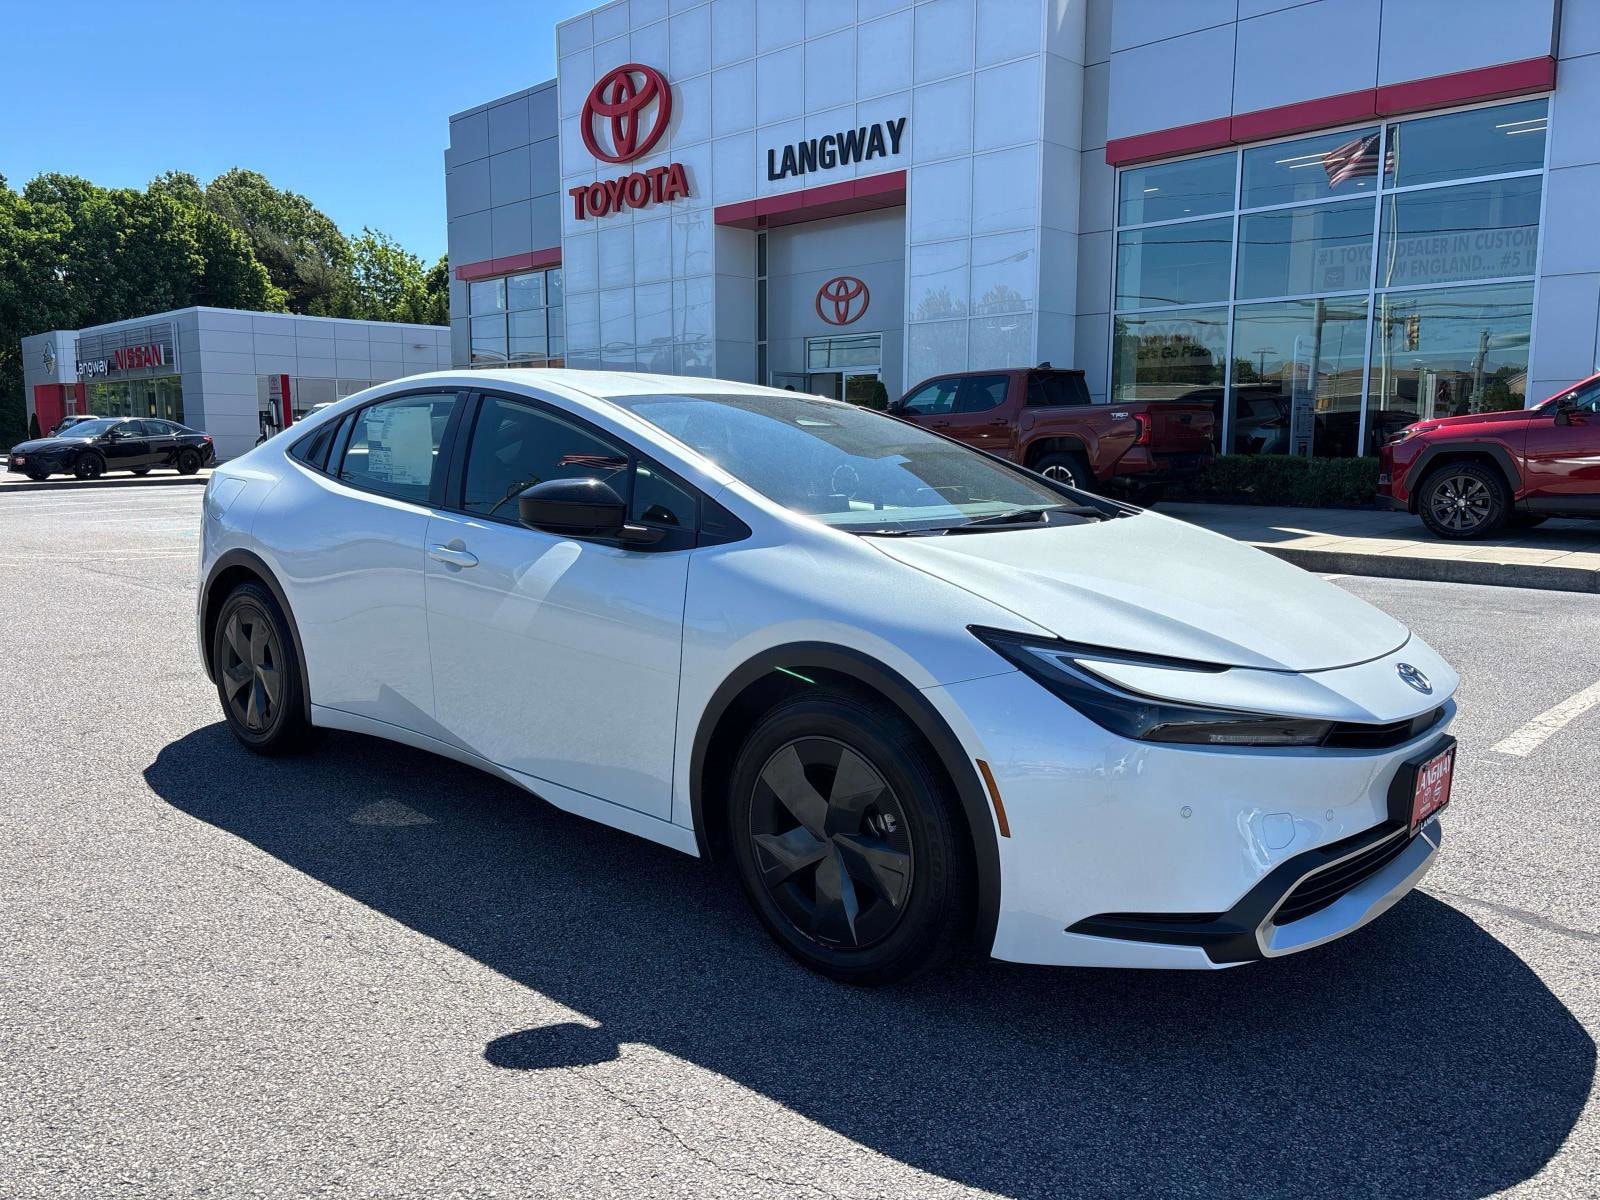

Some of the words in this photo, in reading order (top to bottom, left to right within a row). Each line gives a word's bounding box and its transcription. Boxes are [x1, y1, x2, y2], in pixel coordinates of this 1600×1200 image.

[767, 117, 906, 181] LANGWAY
[568, 162, 690, 220] TOYOTA
[1318, 251, 1335, 266] #1
[1398, 237, 1449, 257] DEALER
[1451, 235, 1471, 252] IN
[1500, 252, 1521, 269] #5
[75, 359, 109, 378] Langway
[114, 344, 165, 370] NISSAN
